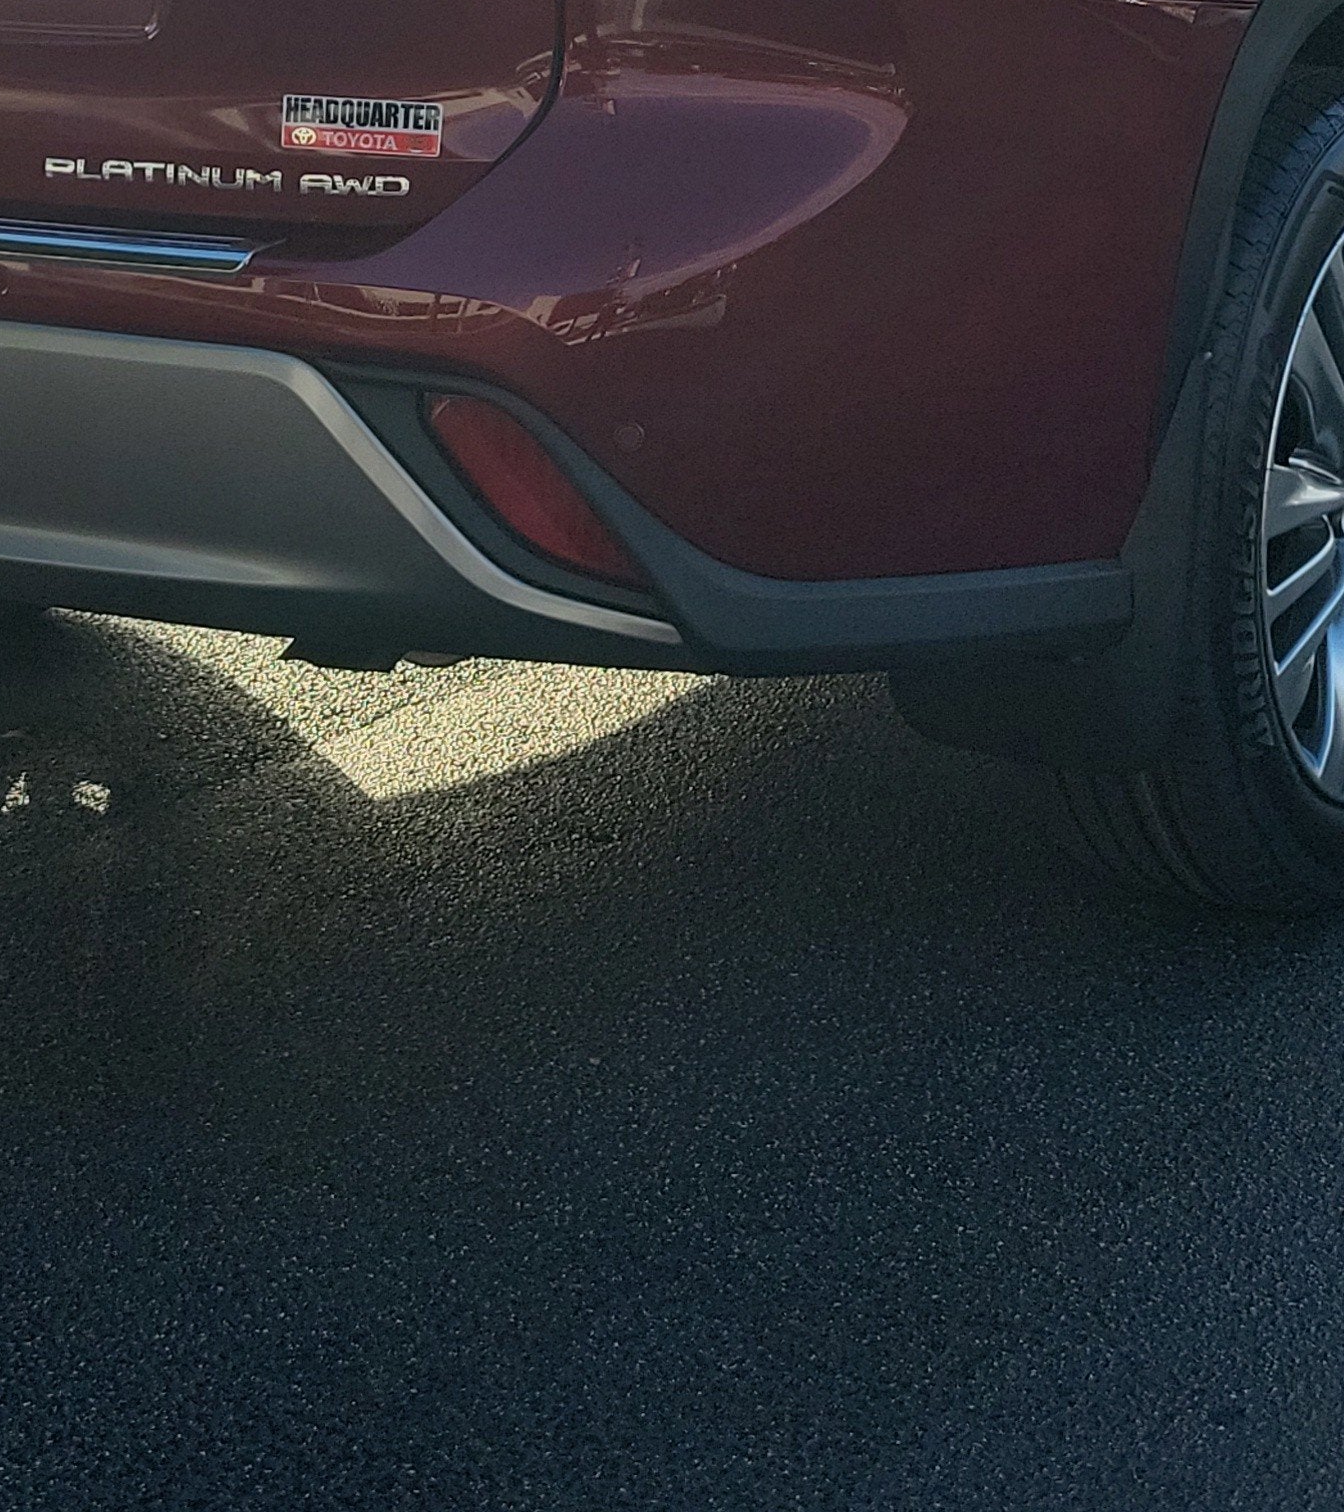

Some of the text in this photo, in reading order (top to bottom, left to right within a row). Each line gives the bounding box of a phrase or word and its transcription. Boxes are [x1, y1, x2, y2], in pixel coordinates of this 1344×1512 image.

[285, 96, 440, 131] HEADQUARTER
[322, 130, 398, 151] TOYOTA
[44, 157, 411, 197] PLATINUM AWD
